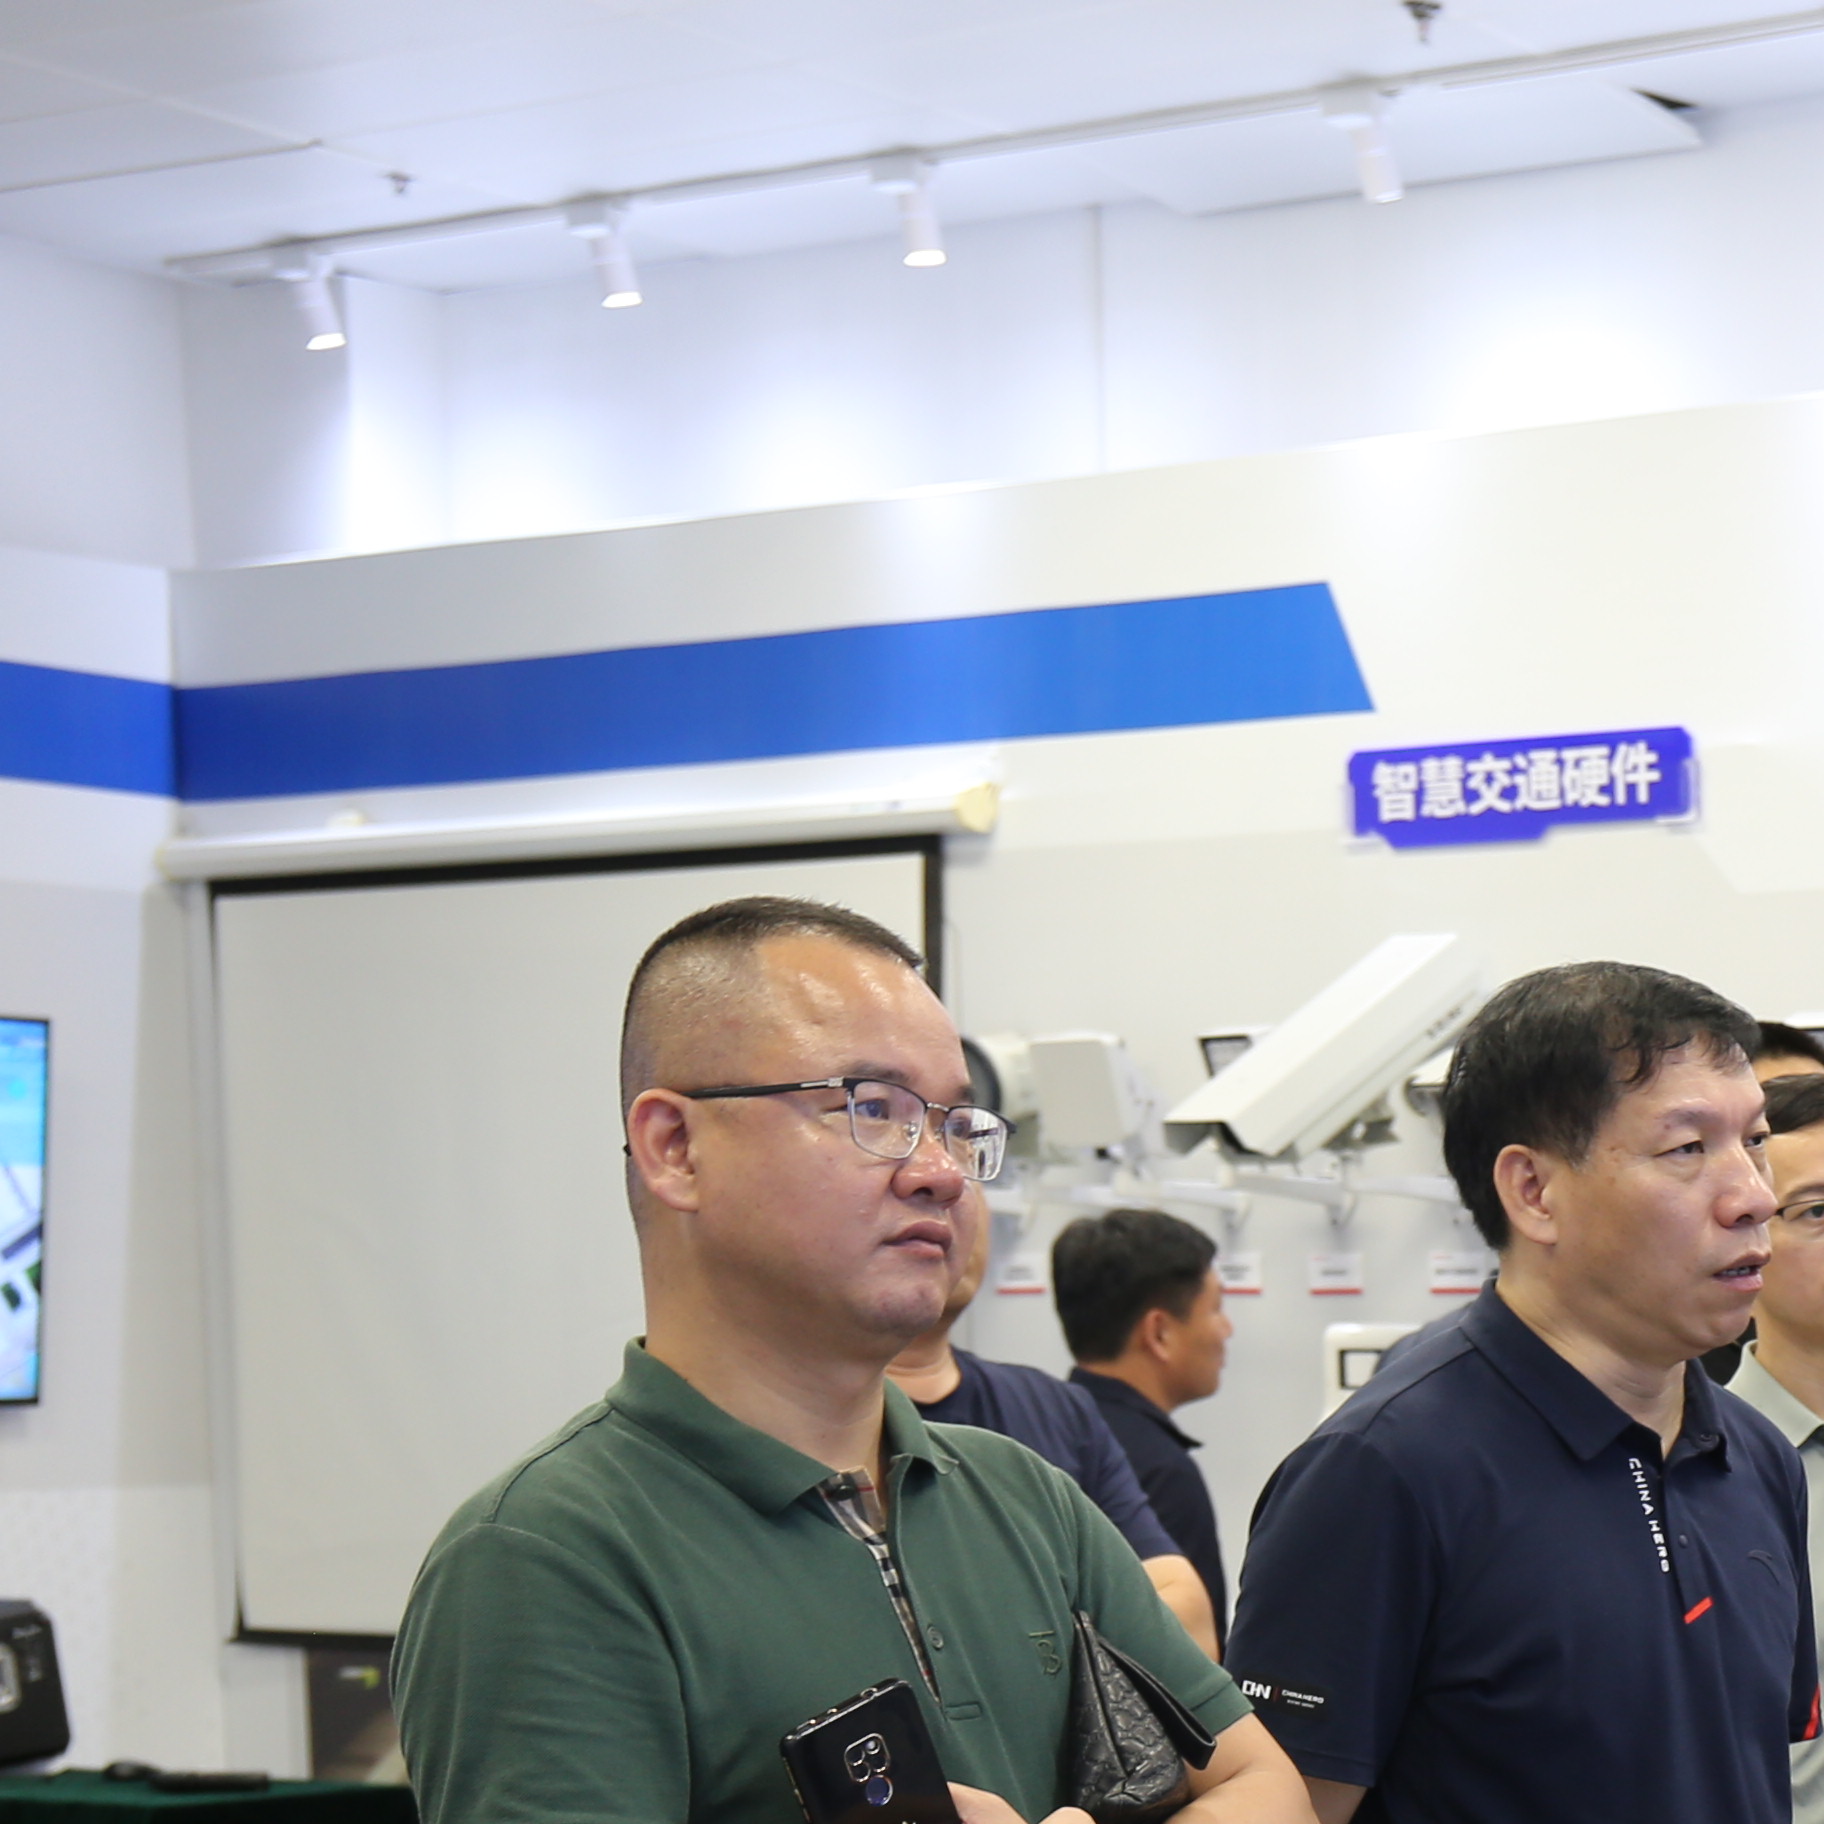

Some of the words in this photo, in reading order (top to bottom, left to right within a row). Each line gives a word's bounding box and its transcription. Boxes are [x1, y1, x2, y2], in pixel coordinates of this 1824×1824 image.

[1372, 740, 1661, 823] 智慧交通硬件
